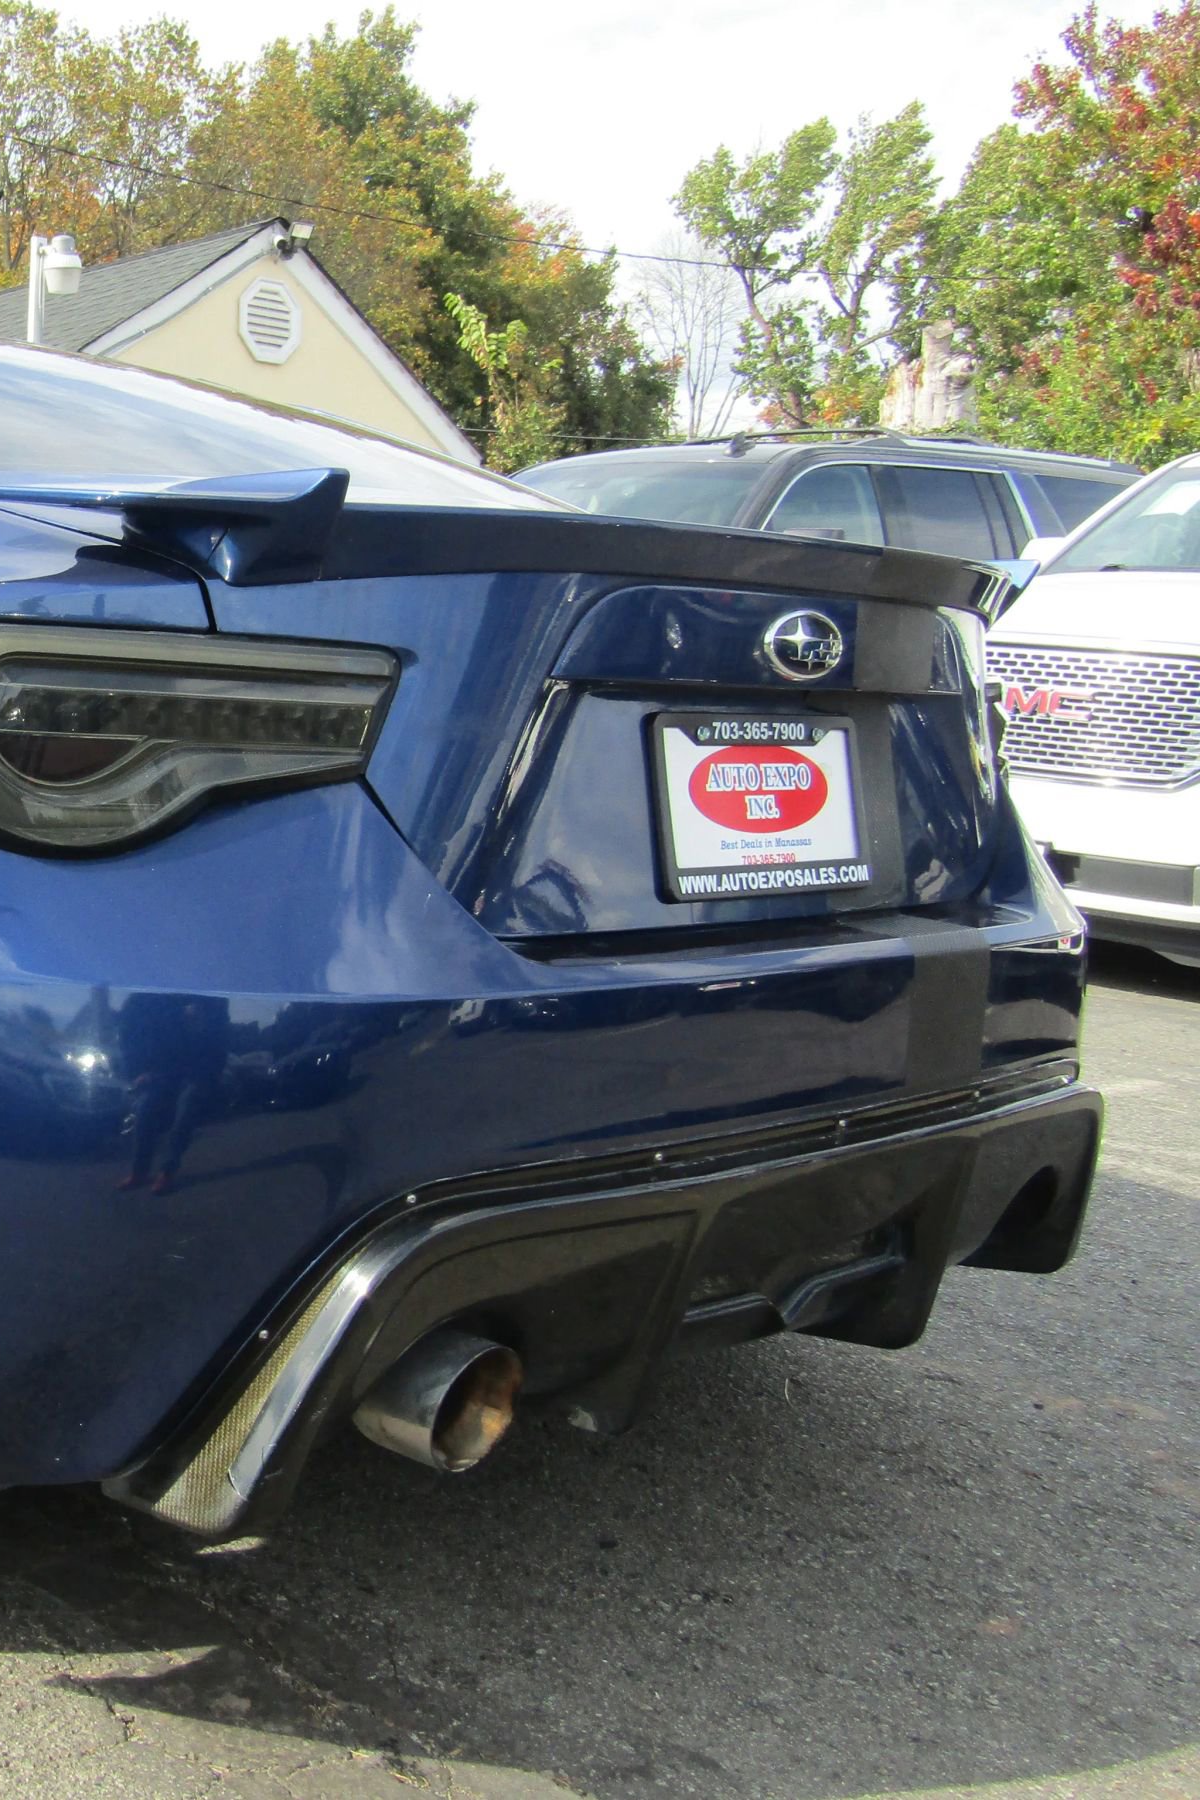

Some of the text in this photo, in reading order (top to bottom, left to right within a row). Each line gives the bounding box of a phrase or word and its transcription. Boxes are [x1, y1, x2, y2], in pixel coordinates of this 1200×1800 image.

[1004, 687, 1095, 721] MC
[712, 721, 805, 741] 703-365-7900
[706, 763, 811, 791] AUTO EXPO
[745, 795, 780, 819] INC.
[721, 837, 812, 850] Best Deals in Manassas
[742, 853, 796, 865] 703-365-7900
[678, 864, 869, 895] WWW.AUTOEXPOSALES.COM
